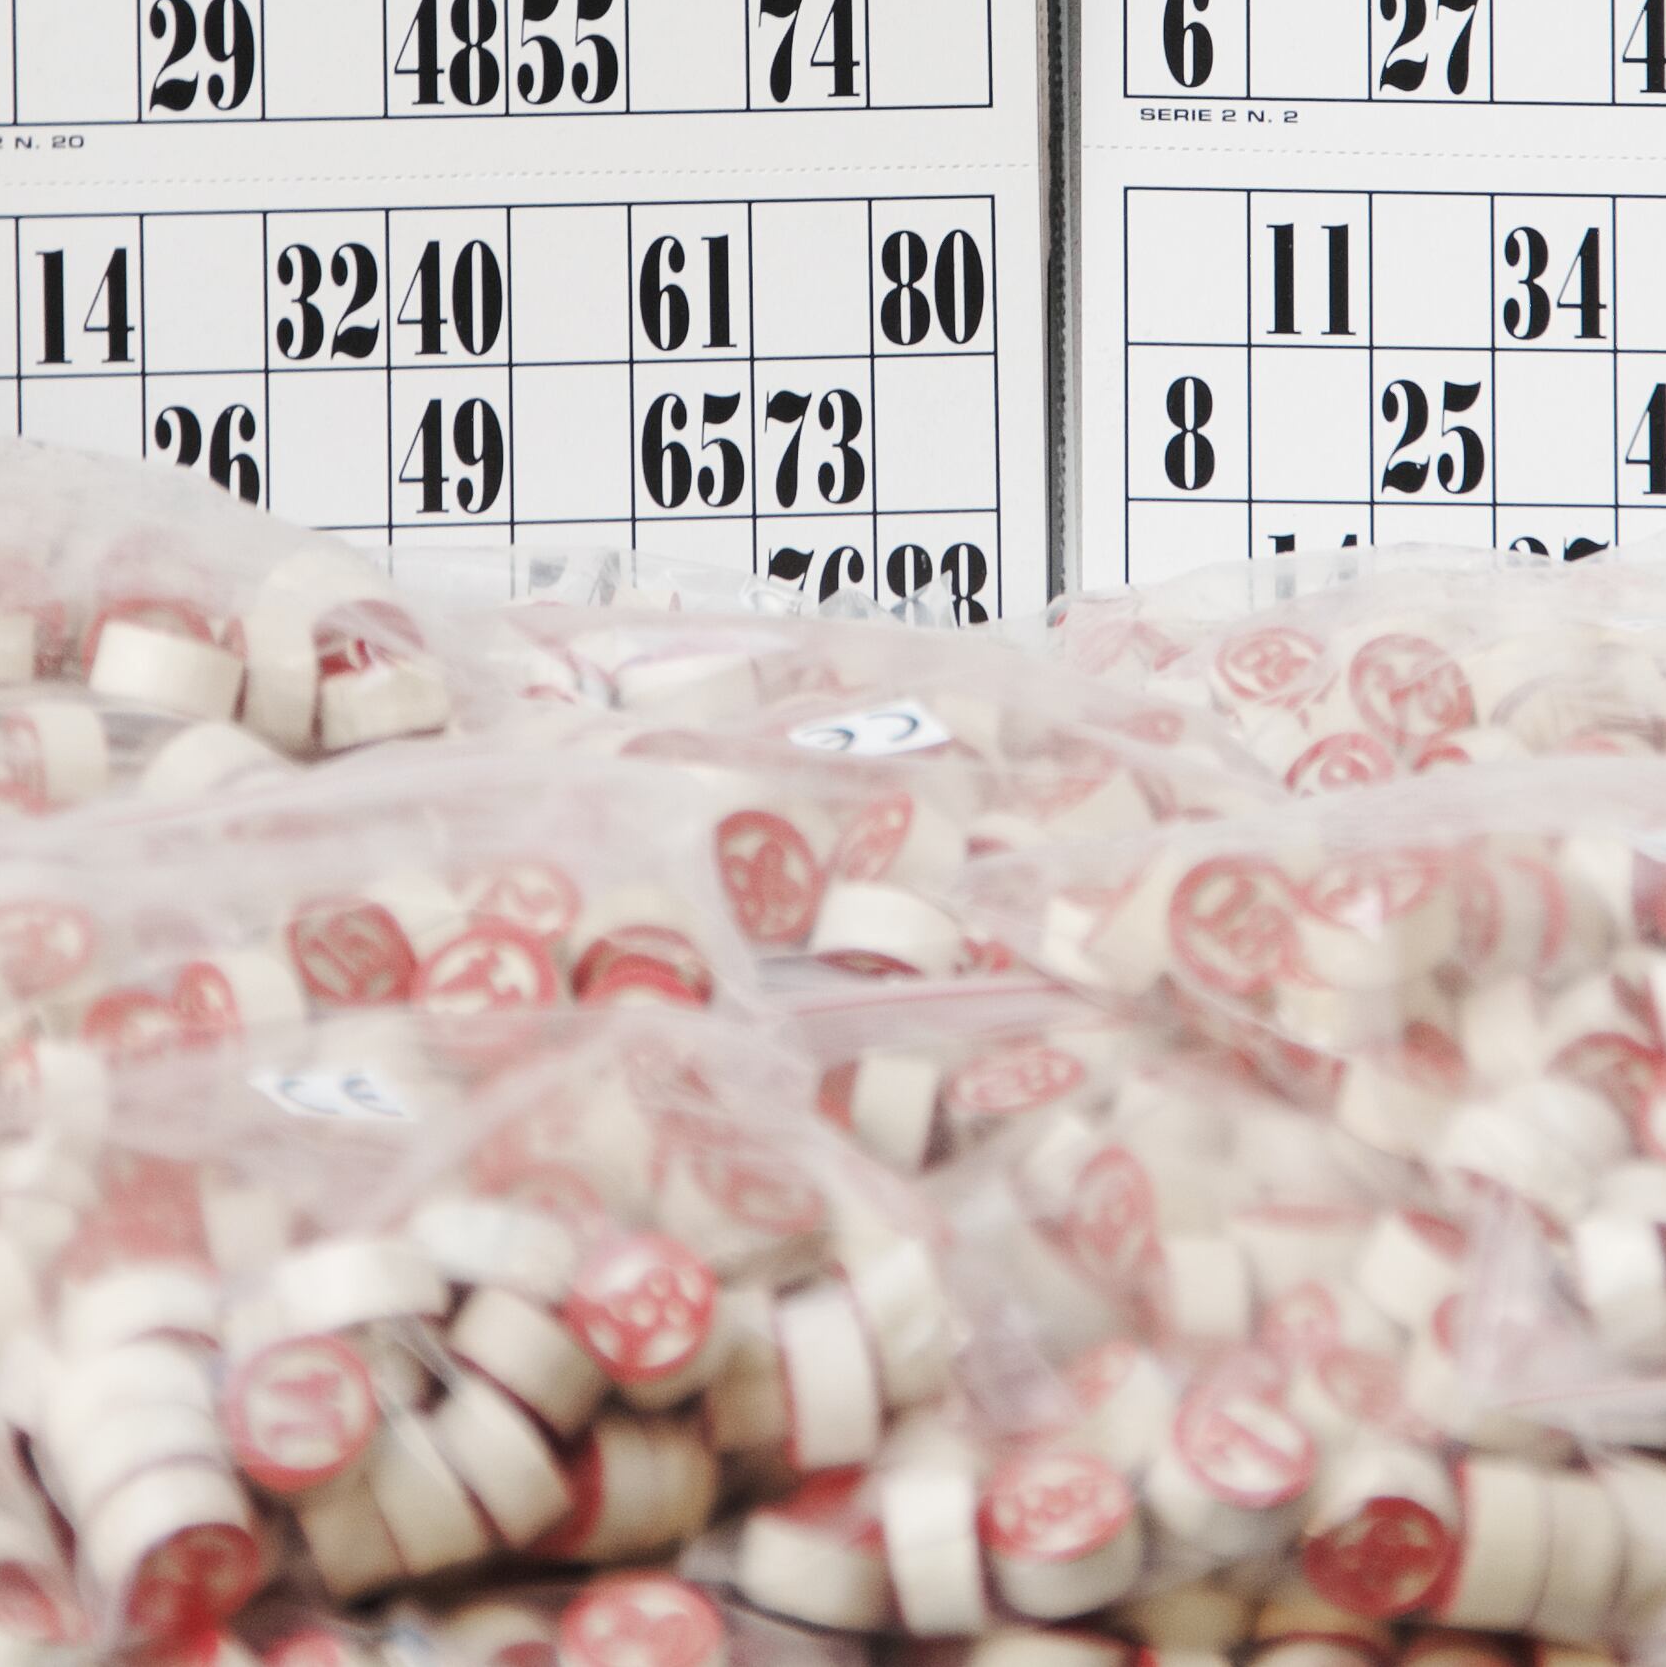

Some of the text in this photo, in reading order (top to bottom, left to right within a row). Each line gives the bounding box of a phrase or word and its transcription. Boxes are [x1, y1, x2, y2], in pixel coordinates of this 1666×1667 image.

[52, 138, 84, 152] 20
[1141, 108, 1211, 121] SERIE
[399, 389, 865, 514] 49 65 73
[1165, 376, 1215, 490] 8
[1382, 380, 1484, 494] 25
